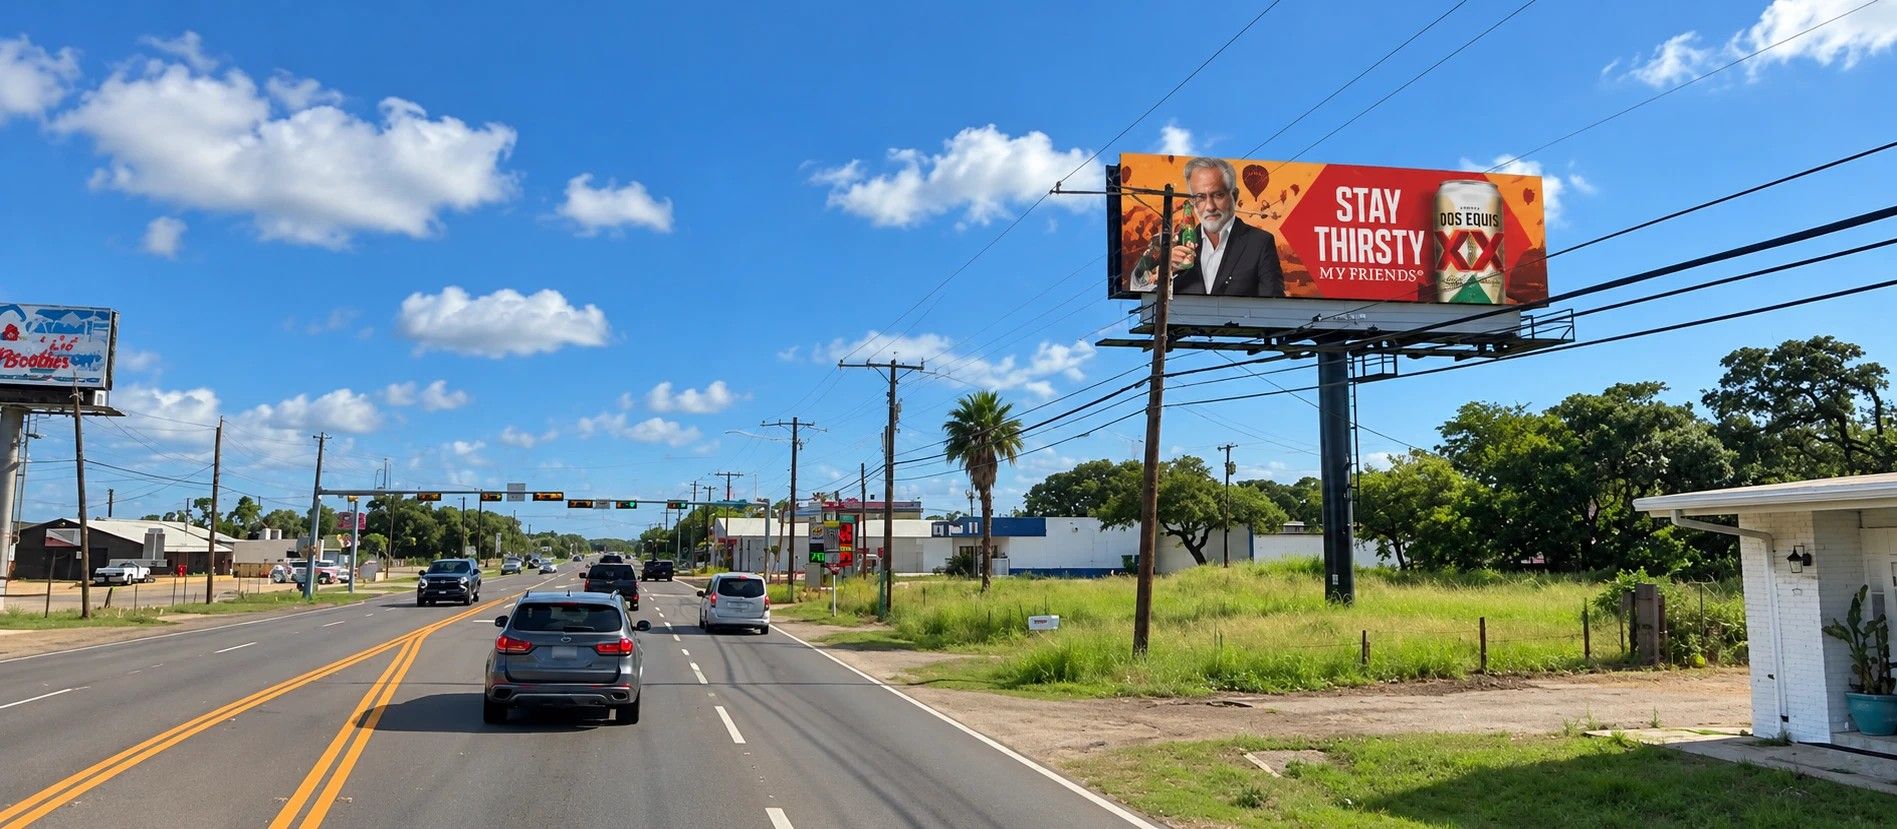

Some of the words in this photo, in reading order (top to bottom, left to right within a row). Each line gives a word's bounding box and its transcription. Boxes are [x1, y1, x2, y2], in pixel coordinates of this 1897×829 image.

[1335, 185, 1402, 224] STAY
[1440, 212, 1462, 227] DOS
[1466, 212, 1499, 228] EQUIS
[1313, 226, 1425, 265] THIRSTY
[1434, 229, 1504, 272] XX
[1319, 267, 1346, 280] MY
